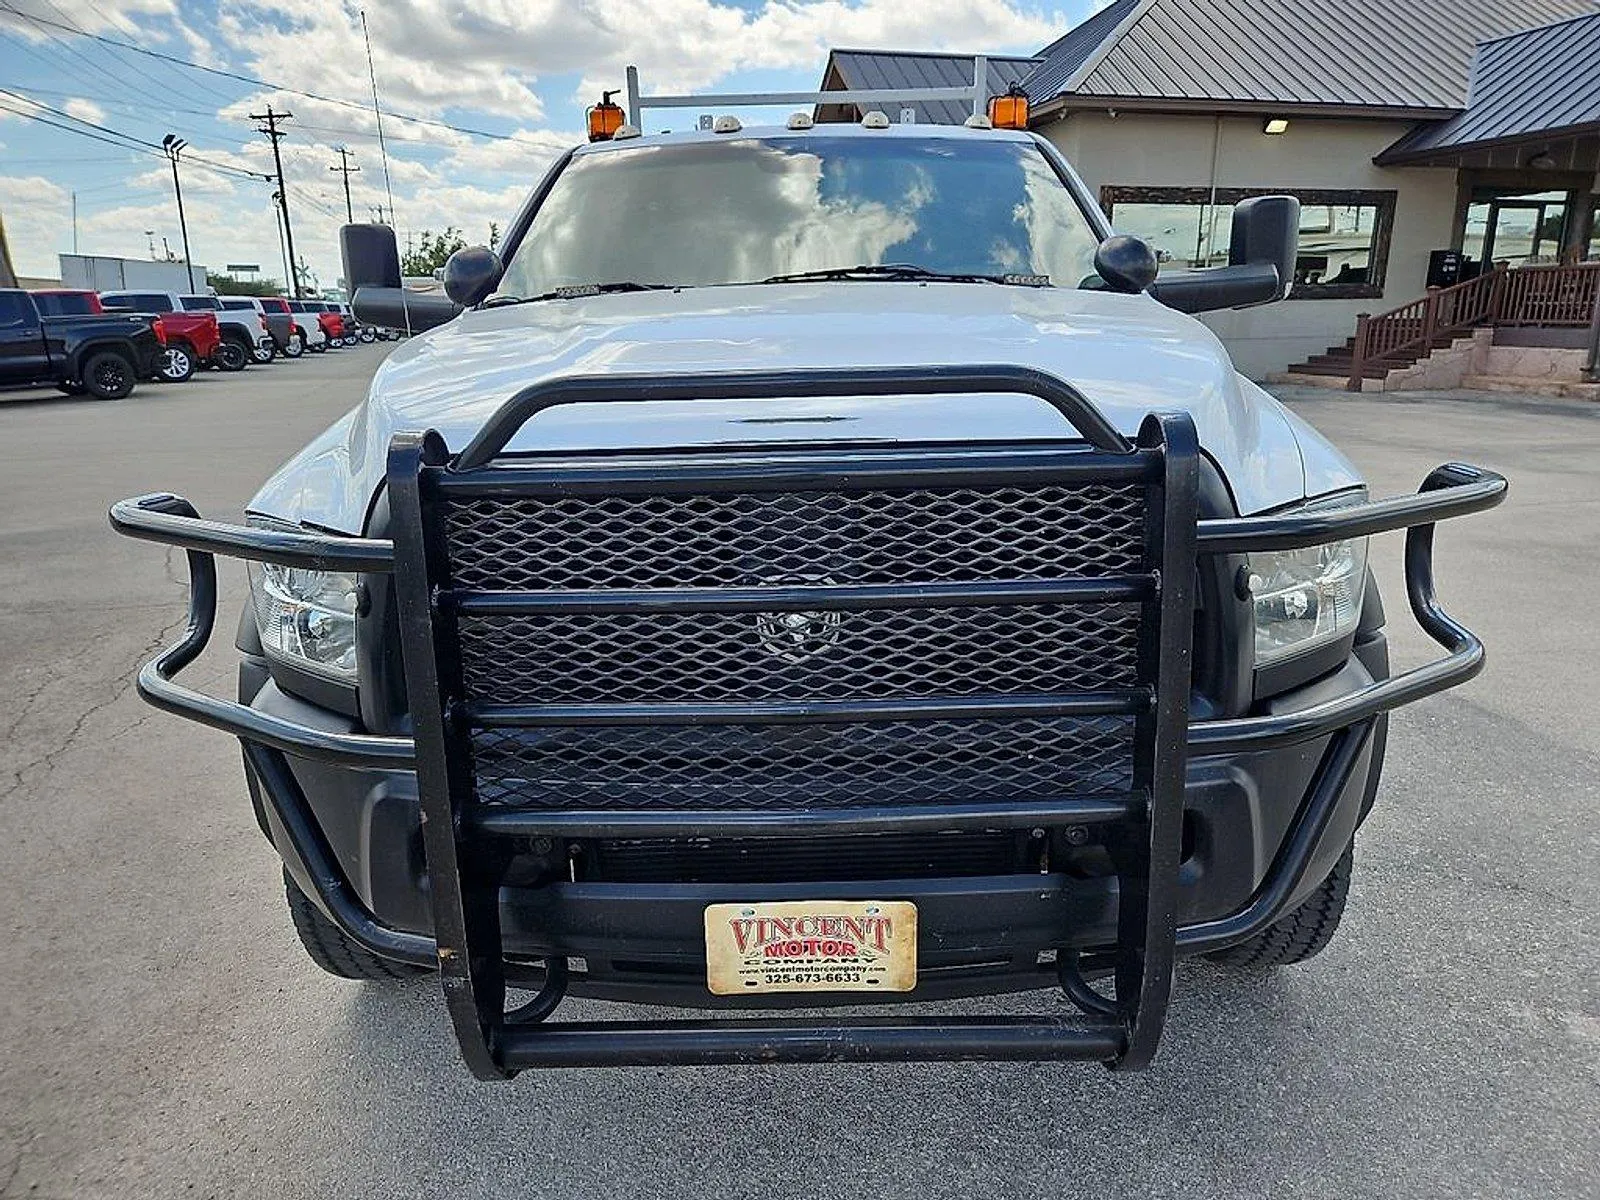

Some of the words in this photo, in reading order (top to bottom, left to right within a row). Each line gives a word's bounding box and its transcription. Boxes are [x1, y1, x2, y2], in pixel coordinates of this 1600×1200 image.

[729, 916, 893, 954] VINCENT
[764, 939, 856, 957] MOTOR
[743, 958, 877, 966] COMPANY
[739, 965, 886, 974] www.vincentmotorcompany.com
[765, 973, 860, 984] 325-673-6633
